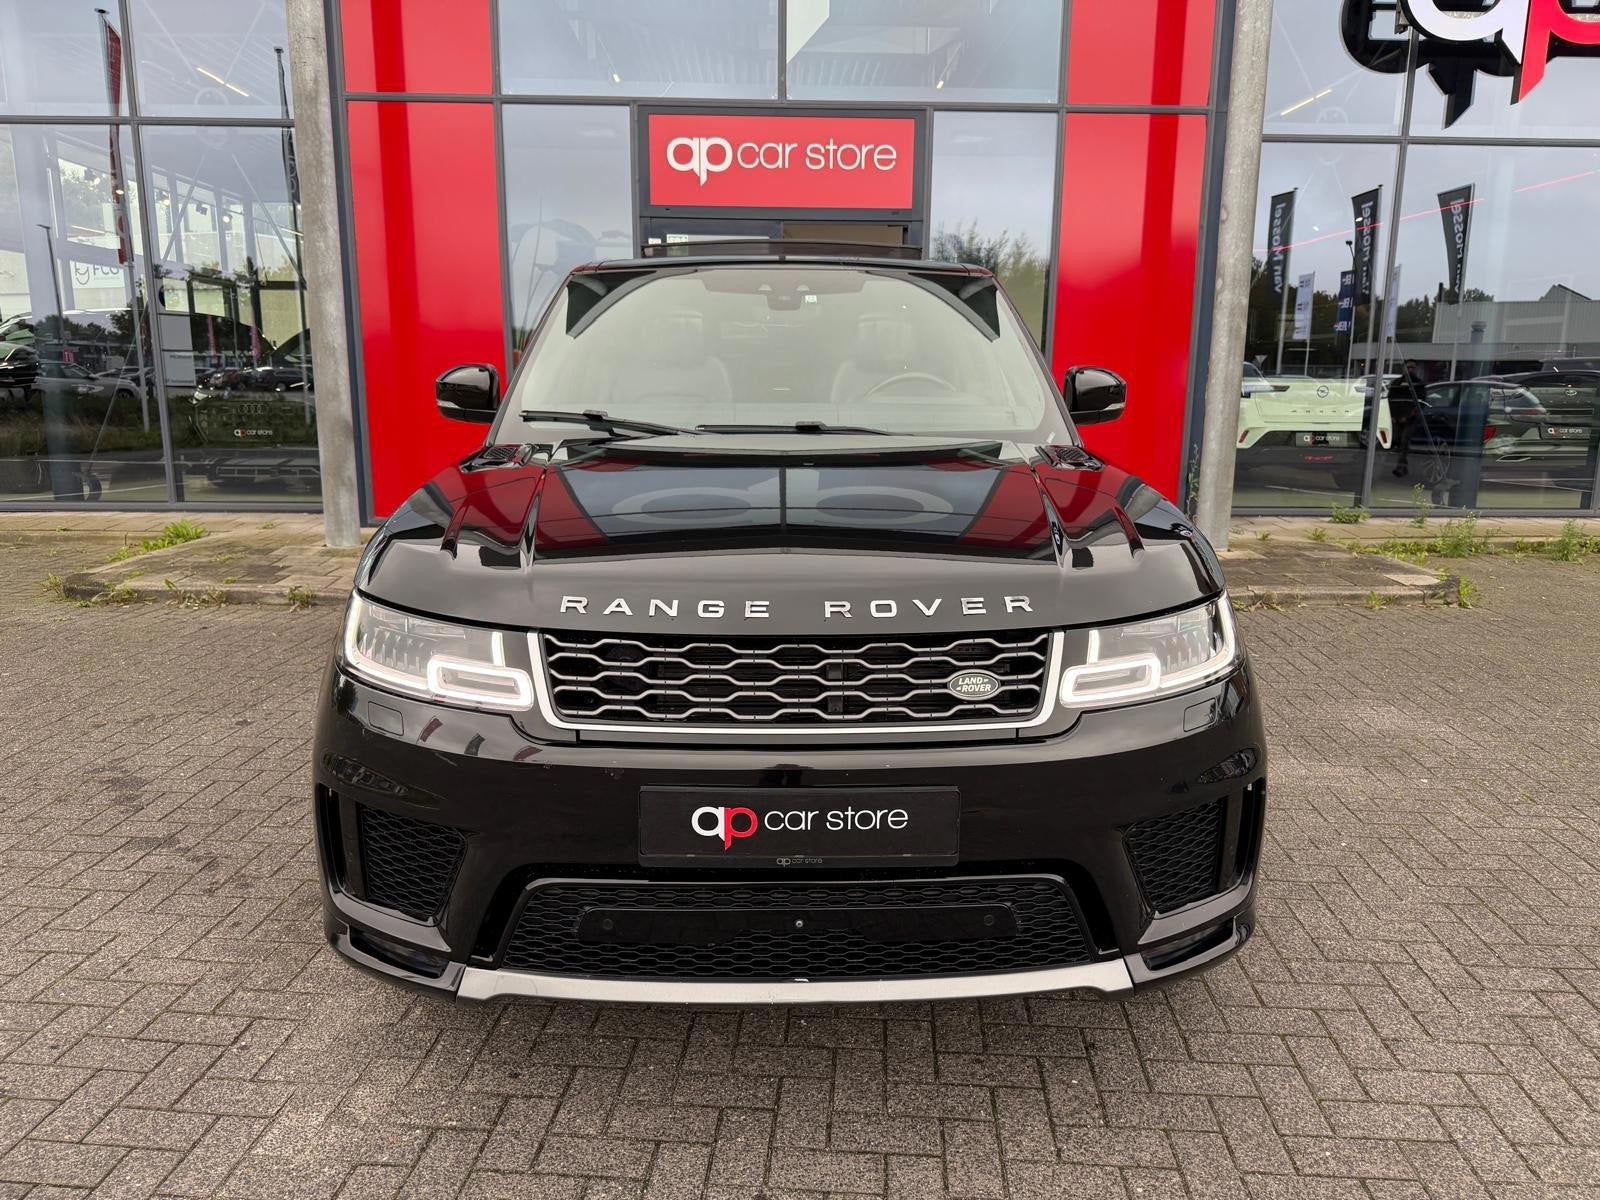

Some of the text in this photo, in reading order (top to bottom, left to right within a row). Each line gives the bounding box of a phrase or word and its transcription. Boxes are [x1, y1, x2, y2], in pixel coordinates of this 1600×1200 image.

[666, 137, 897, 186] ap car store
[559, 595, 1033, 619] RANGE ROVER
[958, 676, 983, 685] LAND
[961, 684, 991, 692] ROVER
[691, 806, 908, 850] ap car store
